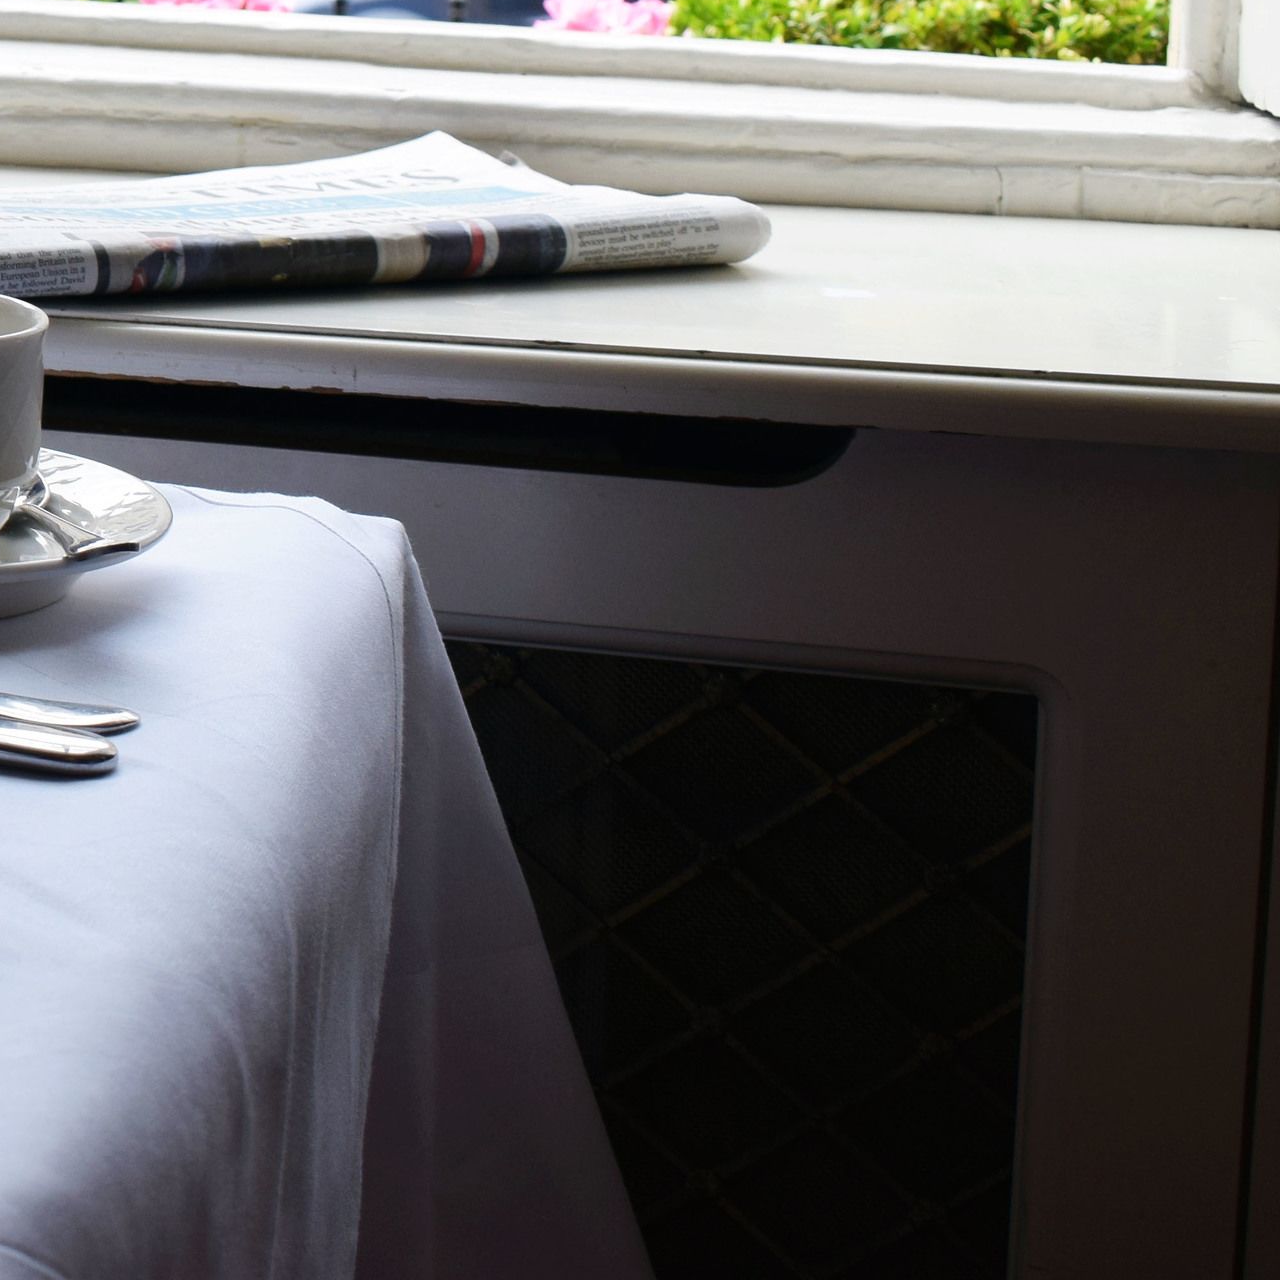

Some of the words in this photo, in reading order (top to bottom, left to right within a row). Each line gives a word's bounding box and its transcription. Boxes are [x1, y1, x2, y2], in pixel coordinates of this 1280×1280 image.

[168, 169, 460, 198] TIMES
[16, 251, 34, 259] that
[37, 256, 66, 266] Britain
[68, 255, 85, 264] into
[0, 270, 40, 282] European
[42, 267, 68, 277] Union
[22, 278, 58, 288] followed
[60, 276, 86, 285] David
